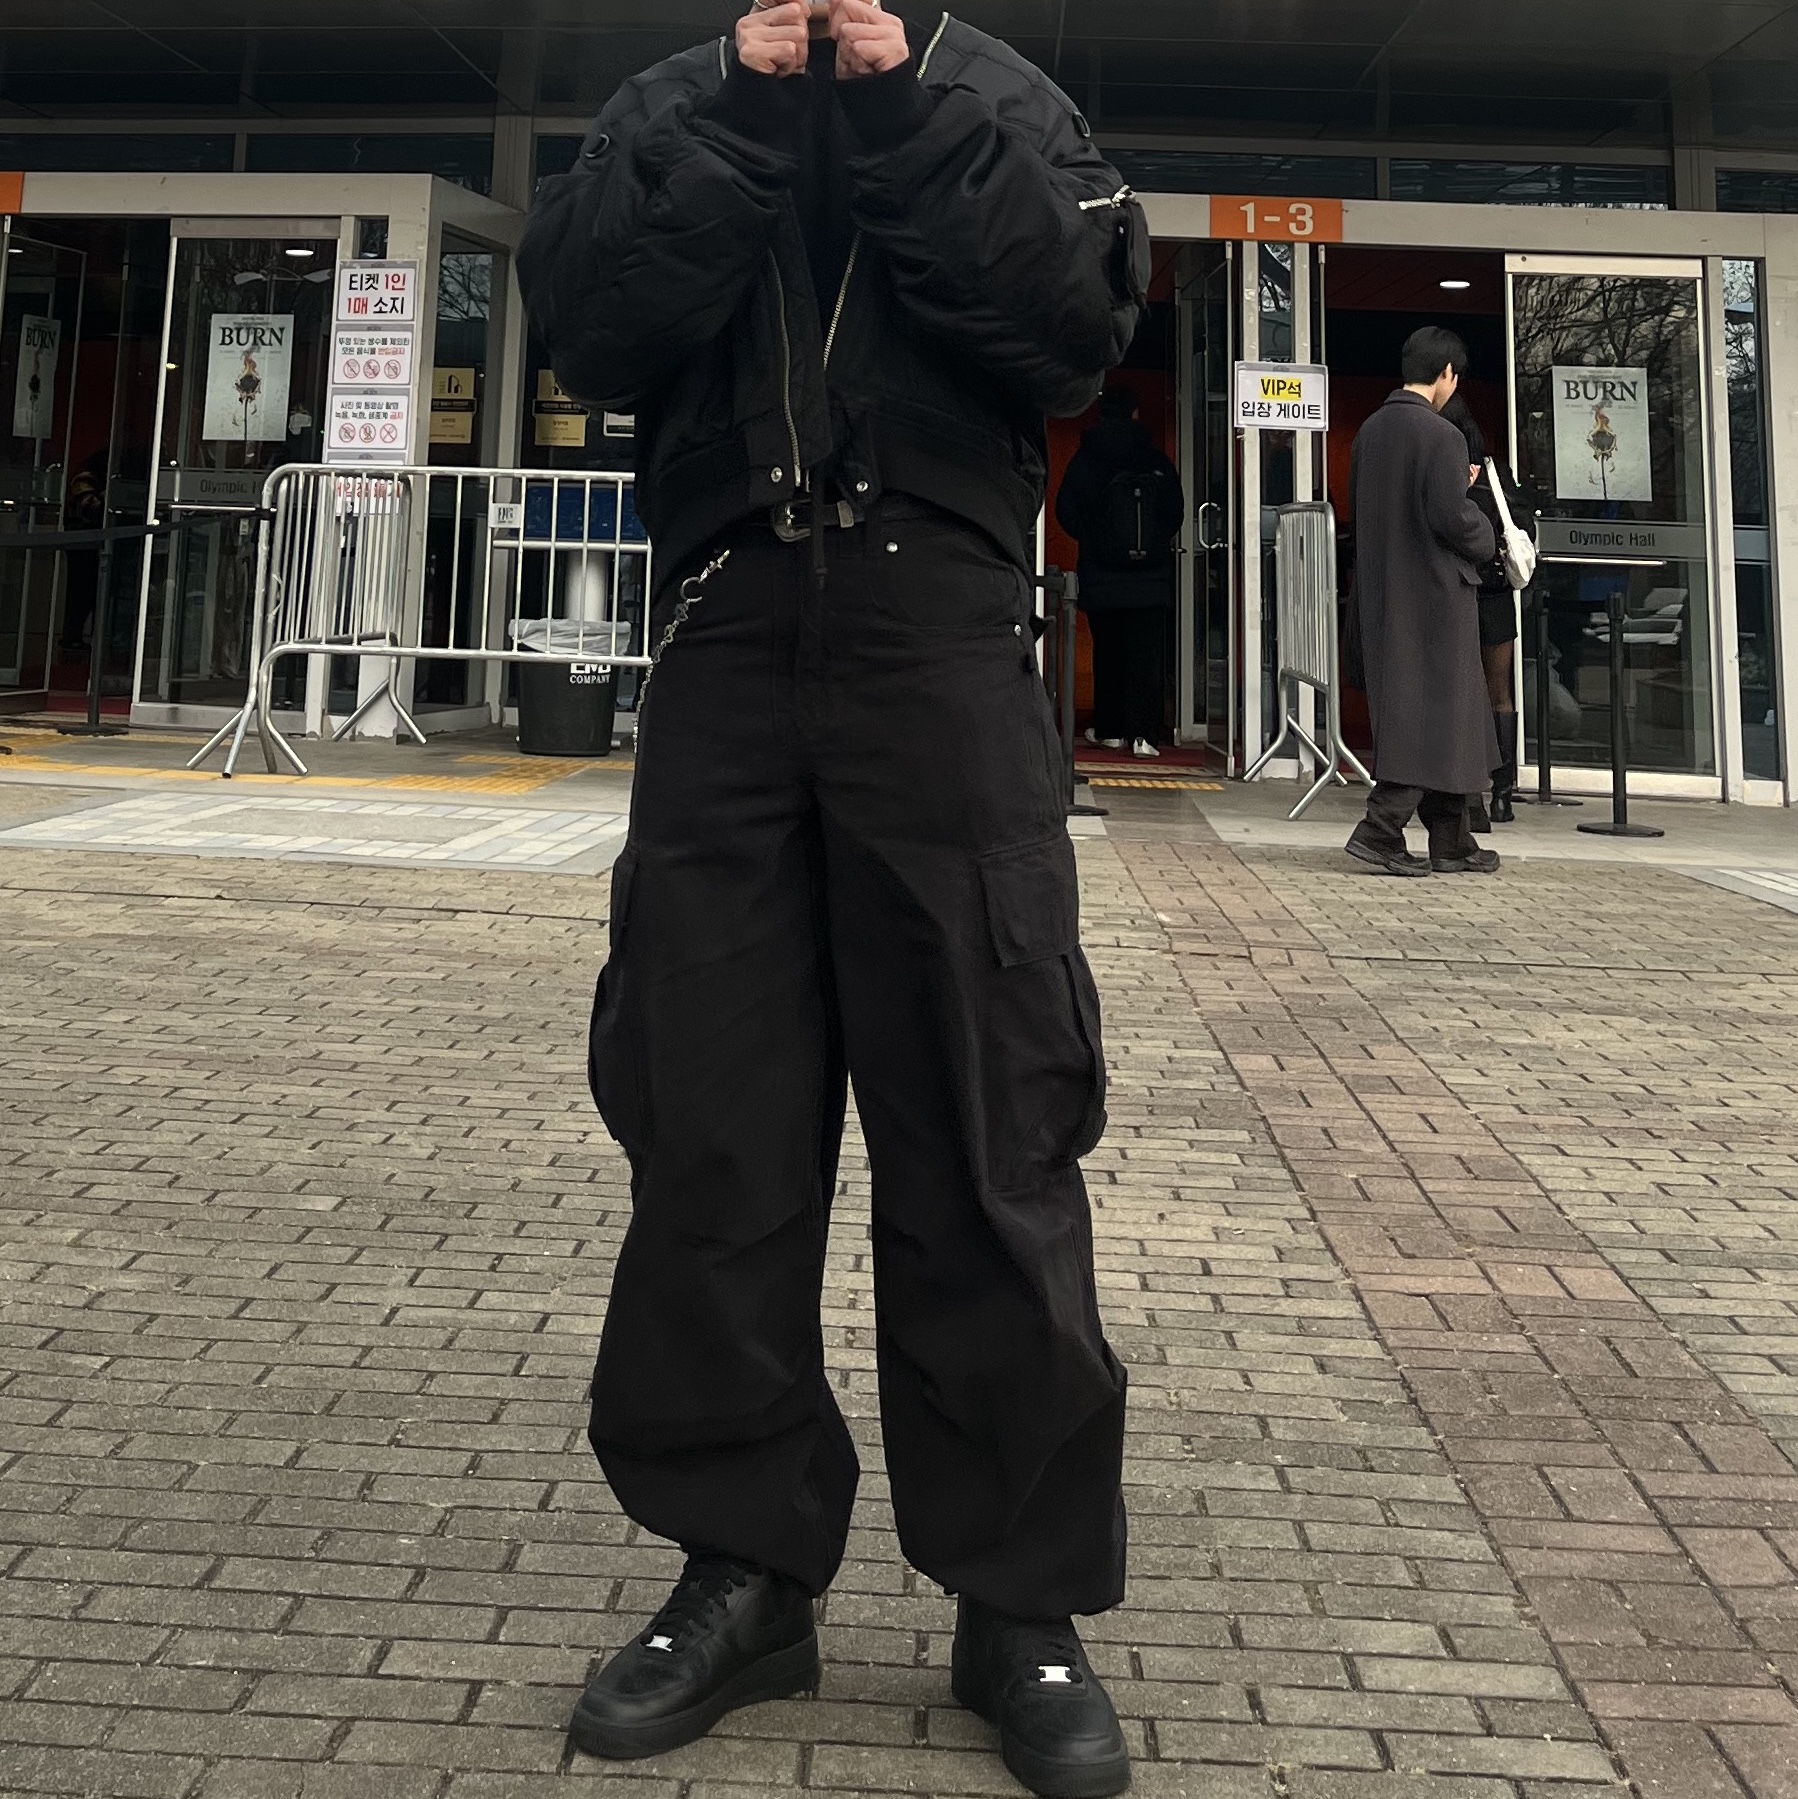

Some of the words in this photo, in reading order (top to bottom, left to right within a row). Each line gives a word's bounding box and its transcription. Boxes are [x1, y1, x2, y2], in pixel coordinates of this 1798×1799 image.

[1239, 201, 1314, 236] 1-3
[348, 273, 380, 291] 티켓
[384, 273, 407, 291] 1인
[347, 297, 369, 314] 1매
[372, 297, 405, 315] 소지
[25, 327, 58, 350] BURN
[218, 326, 286, 347] BURN
[389, 337, 410, 346] 제외한
[1260, 378, 1302, 398] VIP석
[1563, 379, 1639, 402] BURN
[340, 401, 355, 410] 사진
[355, 401, 363, 410] 및
[363, 401, 384, 410] 동영상
[1241, 401, 1273, 418] 입장
[1276, 402, 1322, 420] 게이트
[389, 411, 404, 420] 금지
[200, 479, 248, 495] Olympic
[1569, 530, 1624, 546] Olympic
[1629, 532, 1656, 547] Hall
[569, 674, 610, 684] COMPANY
